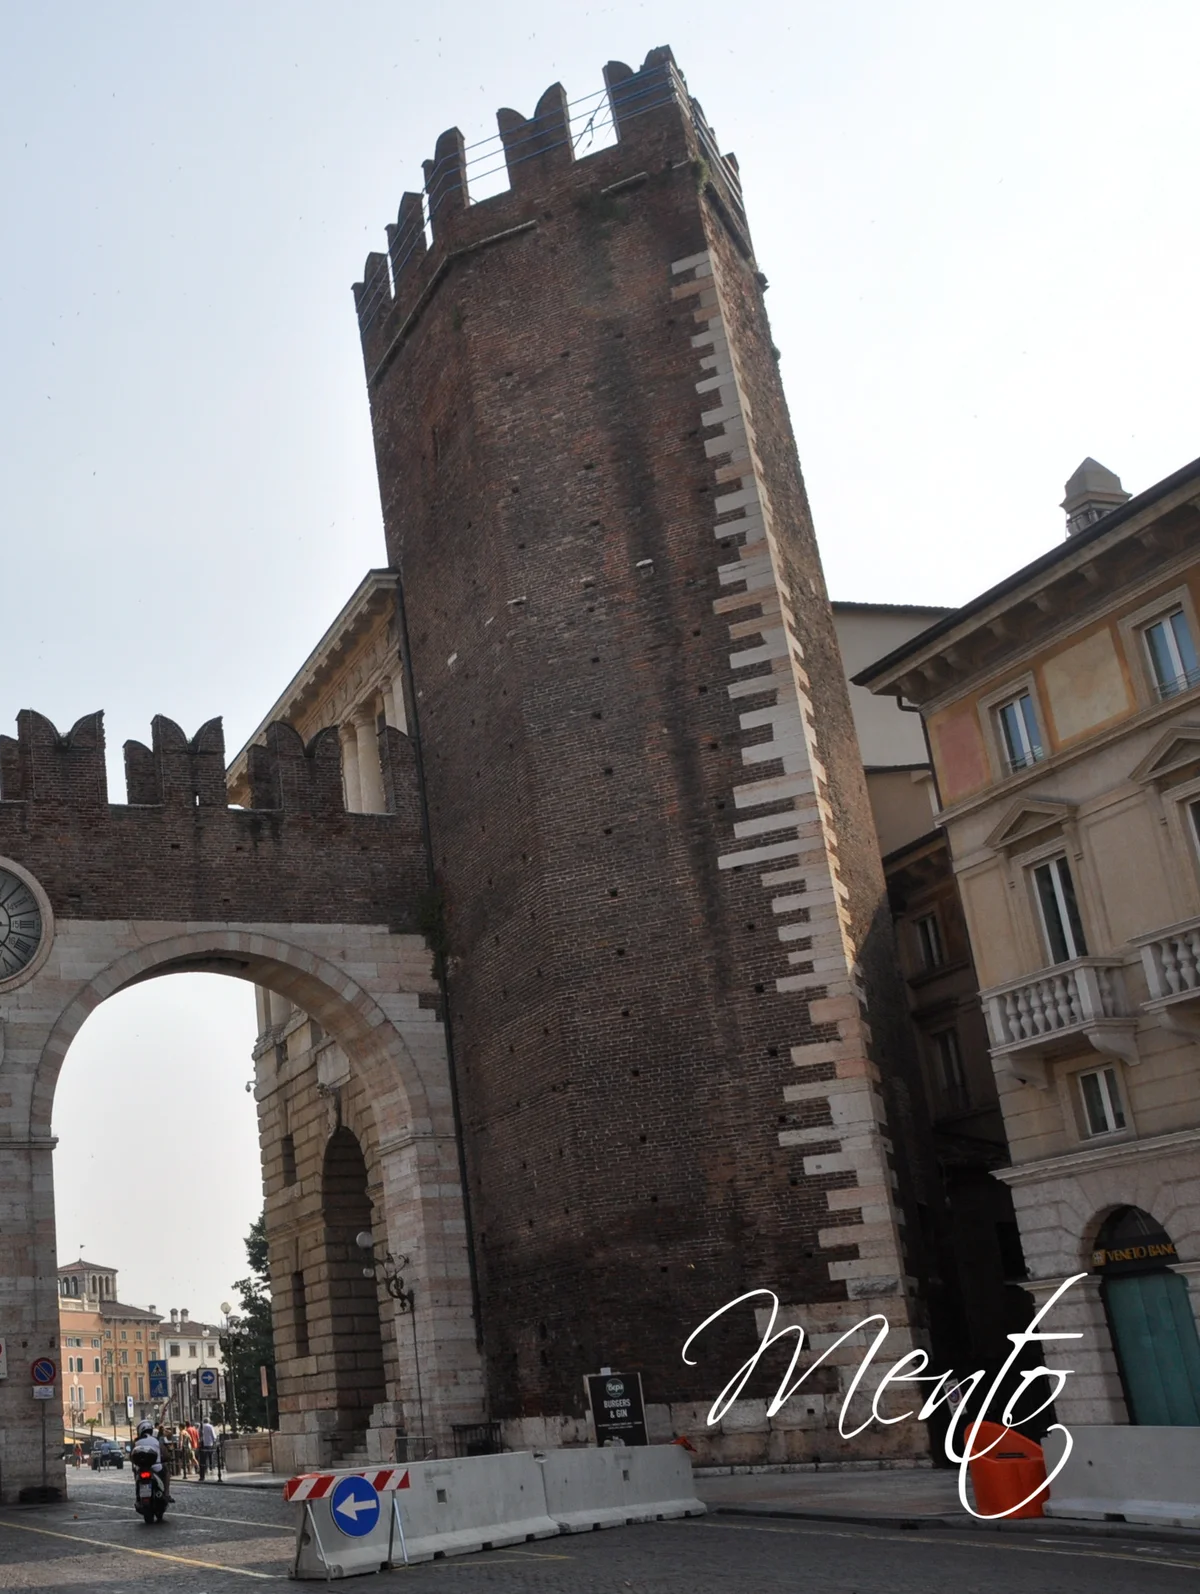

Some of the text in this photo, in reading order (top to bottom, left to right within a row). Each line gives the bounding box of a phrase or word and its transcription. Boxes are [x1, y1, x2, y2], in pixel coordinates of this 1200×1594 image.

[12, 920, 20, 928] 15
[1107, 1246, 1147, 1261] VENETO
[604, 1399, 631, 1408] BURGERS
[616, 1409, 628, 1418] GIN
